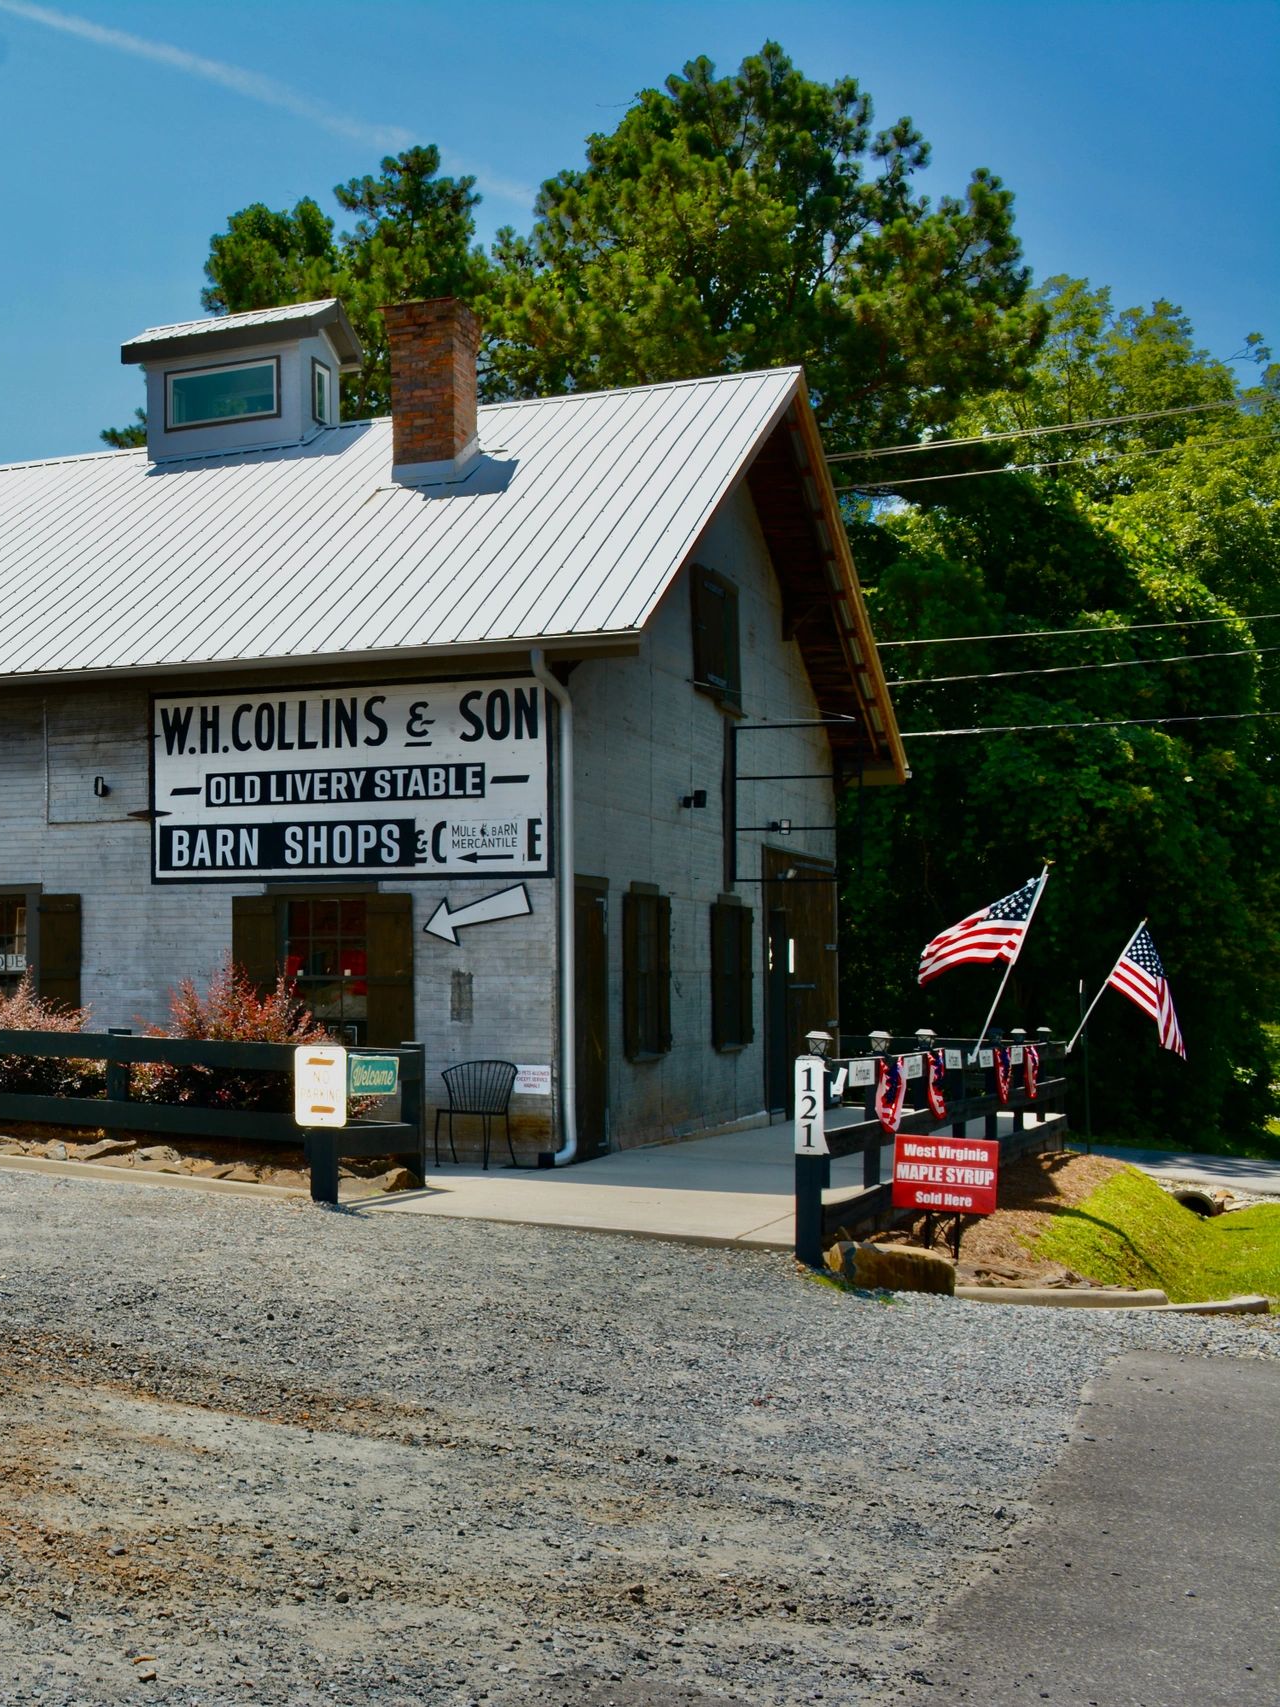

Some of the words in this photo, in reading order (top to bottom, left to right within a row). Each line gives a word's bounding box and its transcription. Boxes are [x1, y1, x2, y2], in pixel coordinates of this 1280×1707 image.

[404, 700, 436, 748] &
[459, 686, 540, 743] SON
[209, 776, 261, 805] OLD
[269, 770, 367, 803] LIVERY
[373, 765, 483, 800] STABLE
[451, 825, 477, 838] MULE
[491, 822, 519, 836] BARN
[171, 827, 260, 868] BARN
[284, 822, 402, 866] SHOPS
[451, 837, 519, 849] MERCANTILE
[313, 1070, 331, 1085] NO
[352, 1064, 395, 1087] Welcome
[300, 1087, 342, 1103] PARKING
[800, 1066, 818, 1148] 121
[903, 1143, 937, 1158] West
[938, 1145, 989, 1162] Virginia
[896, 1163, 943, 1182] MAPLE
[945, 1167, 995, 1186] SYRUP
[915, 1190, 942, 1205] Sold
[943, 1193, 973, 1208] Here
